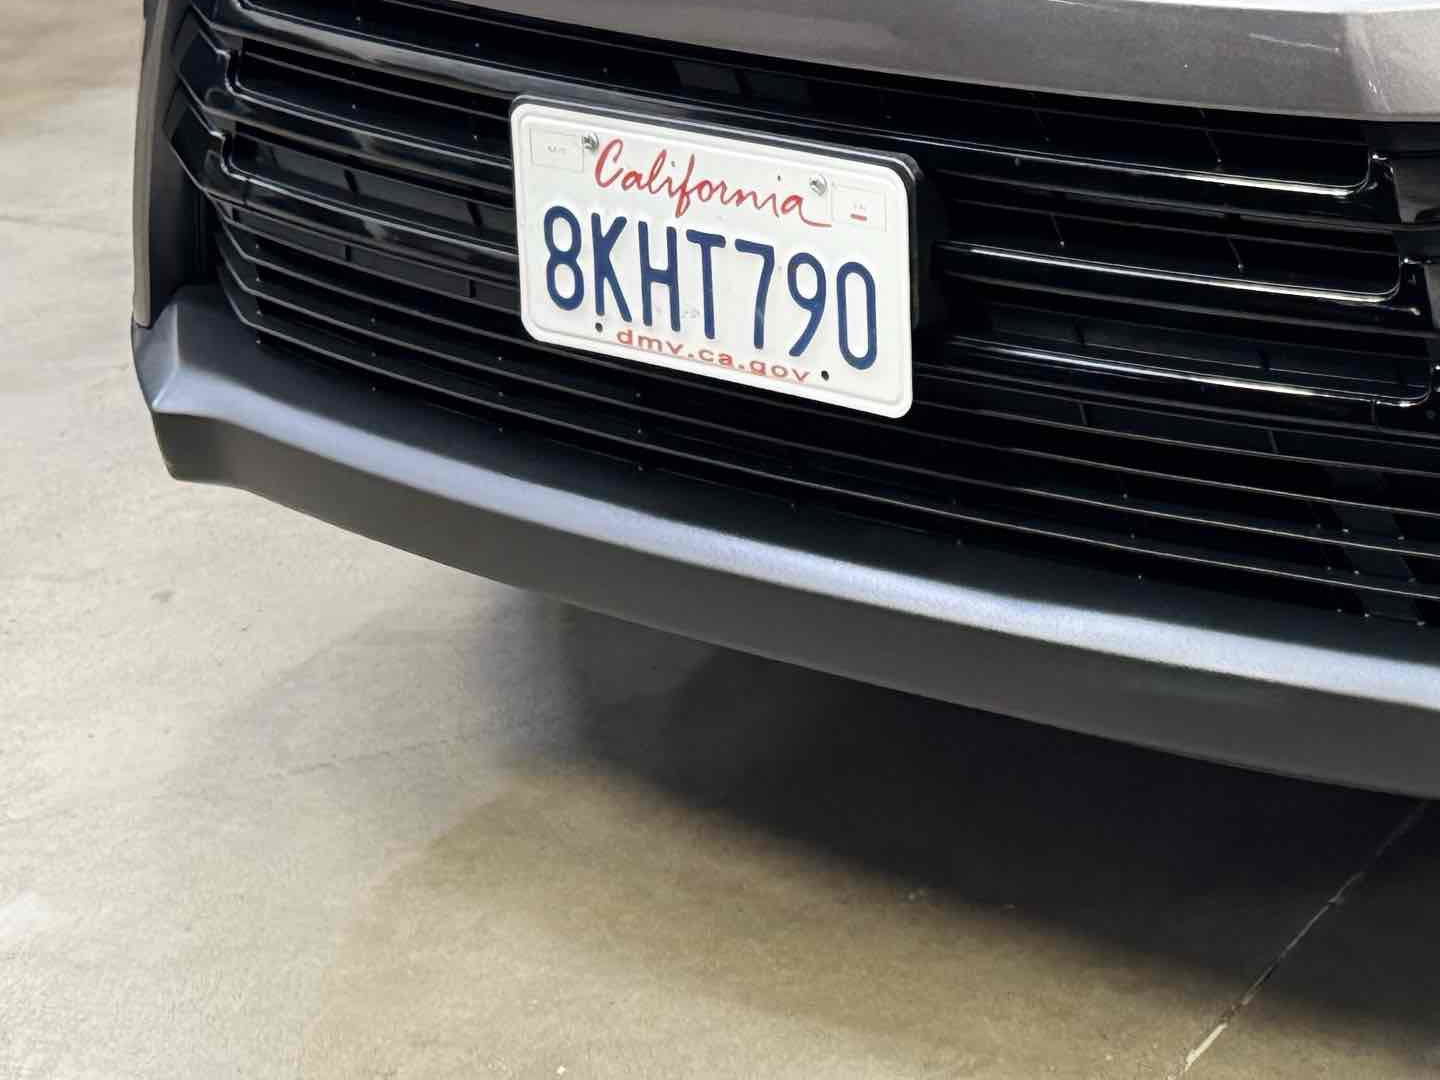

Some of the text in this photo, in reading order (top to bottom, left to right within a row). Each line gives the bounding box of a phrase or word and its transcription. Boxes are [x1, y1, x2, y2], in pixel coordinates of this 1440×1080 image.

[594, 138, 832, 227] California
[543, 205, 878, 370] 8KHT790
[616, 328, 811, 384] dmv.ca.gov
